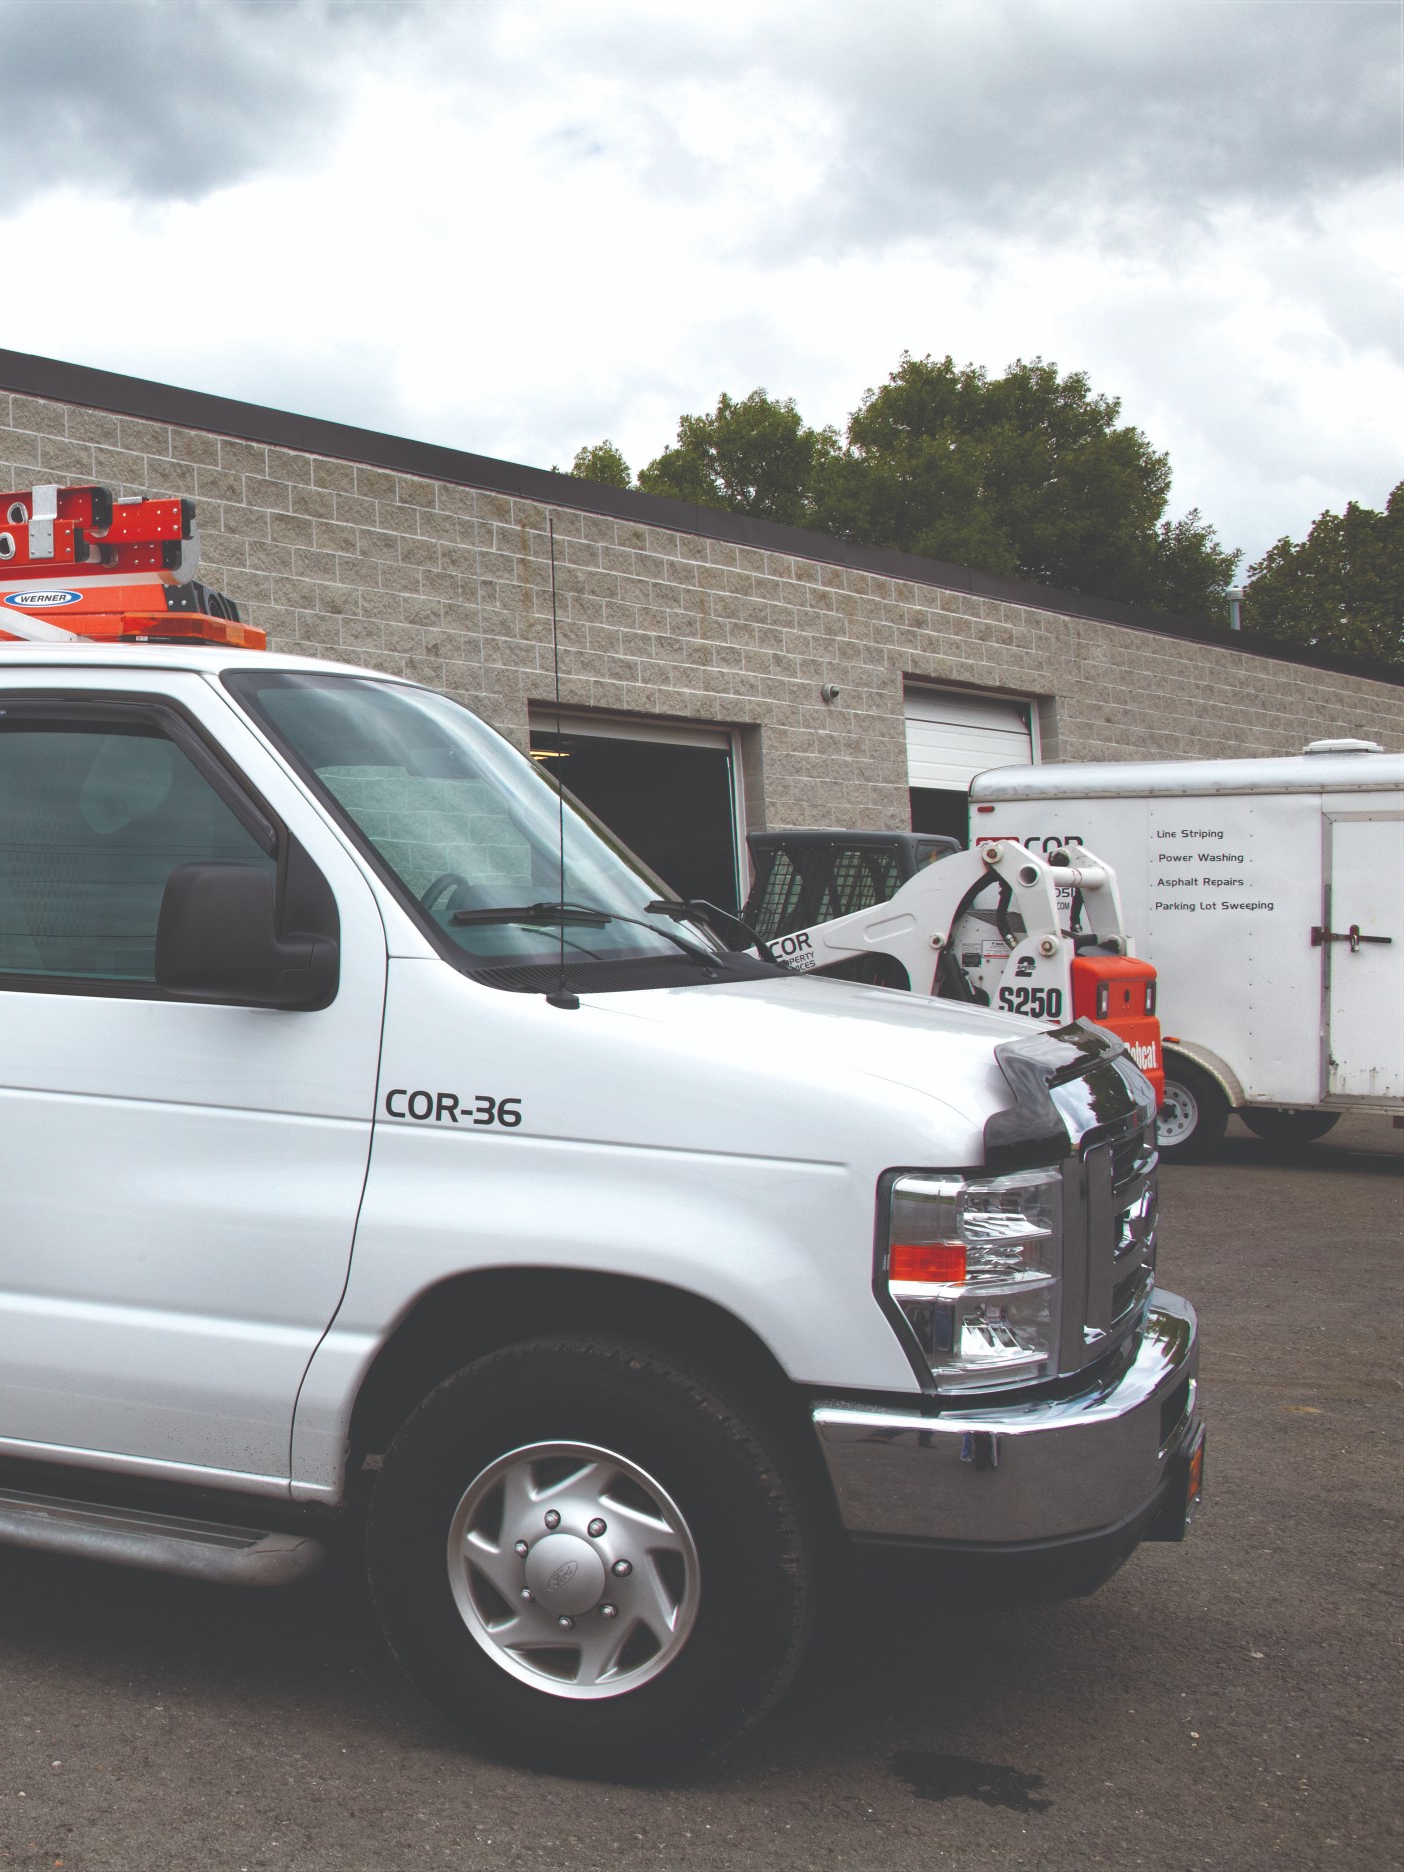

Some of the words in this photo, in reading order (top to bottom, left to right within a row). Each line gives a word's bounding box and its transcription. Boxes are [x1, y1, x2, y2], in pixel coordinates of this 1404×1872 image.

[20, 595, 67, 603] WERNER
[1156, 829, 1177, 839] Line
[1180, 829, 1224, 840] Striping
[1158, 853, 1194, 863] Power
[1197, 853, 1244, 864] Washing
[1156, 877, 1199, 889] Asphalt
[1202, 877, 1245, 888] Repairs
[1155, 901, 1196, 913] Parking
[1199, 901, 1217, 911] Lot
[1221, 900, 1274, 912] Sweeping
[769, 932, 812, 958] COR
[788, 951, 814, 966] PERTY
[1014, 955, 1036, 978] 2
[998, 986, 1062, 1019] S250
[385, 1088, 522, 1128] COR-36
